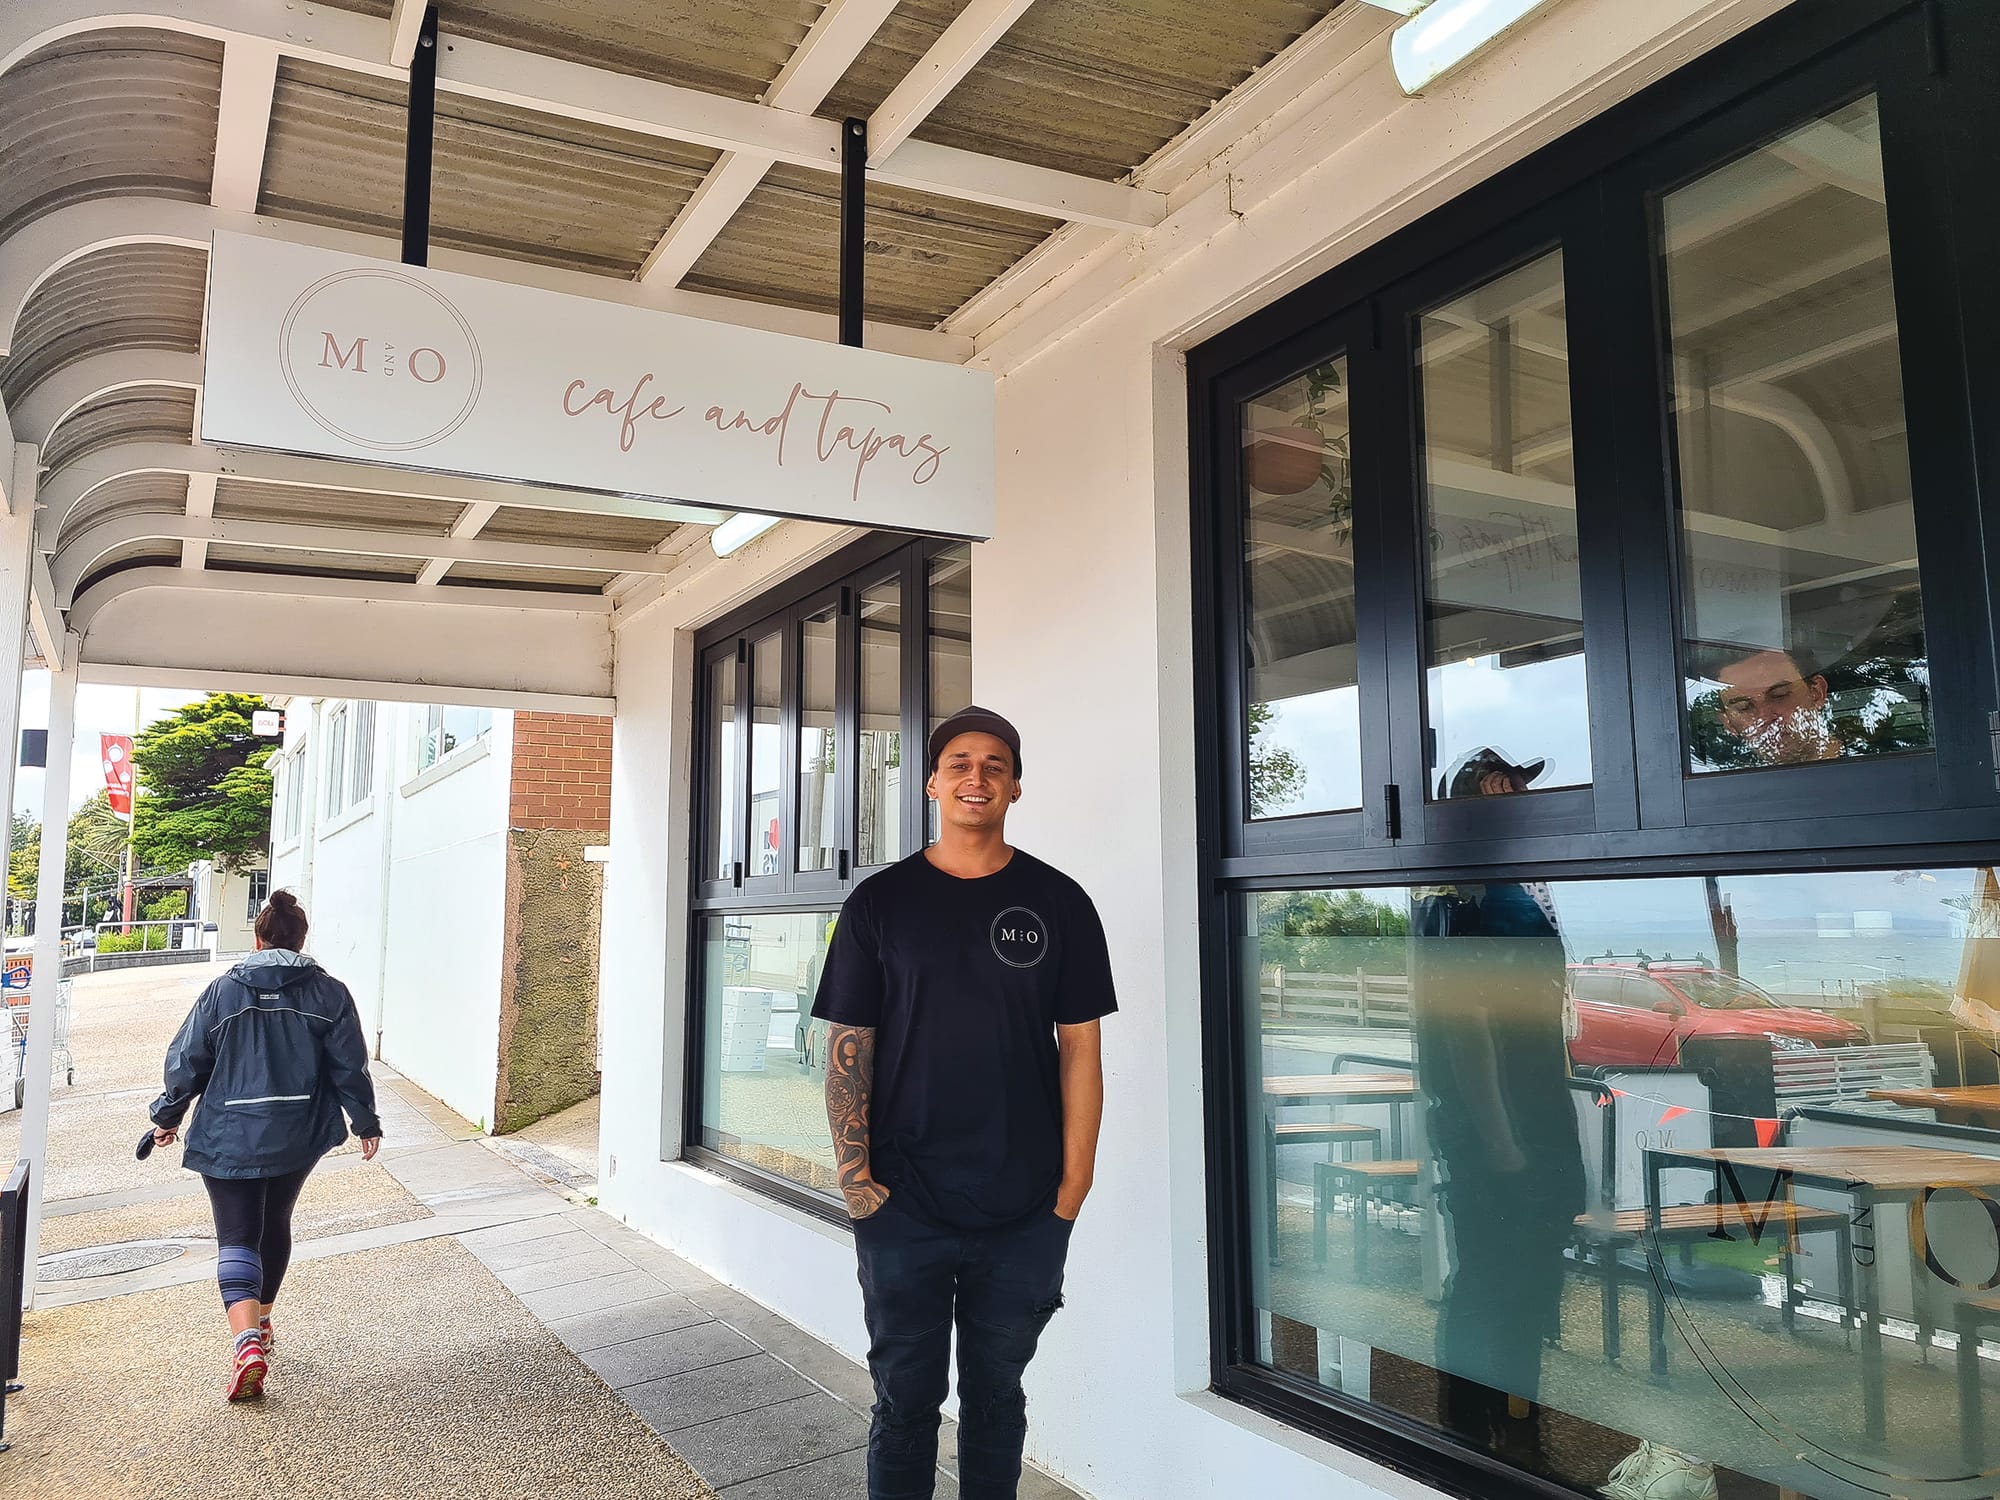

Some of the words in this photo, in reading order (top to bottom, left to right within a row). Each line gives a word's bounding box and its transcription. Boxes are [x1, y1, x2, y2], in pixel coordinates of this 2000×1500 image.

[318, 332, 369, 373] M
[384, 342, 396, 377] AND
[408, 347, 447, 384] O
[563, 373, 685, 453] cafe
[704, 382, 802, 466] and
[801, 388, 951, 501] tapas
[1001, 928, 1016, 942] M
[1026, 931, 1038, 944] O
[798, 1027, 817, 1068] M
[1706, 1149, 1813, 1257] M
[1845, 1169, 1876, 1268] AND
[1909, 1180, 2000, 1291] O
